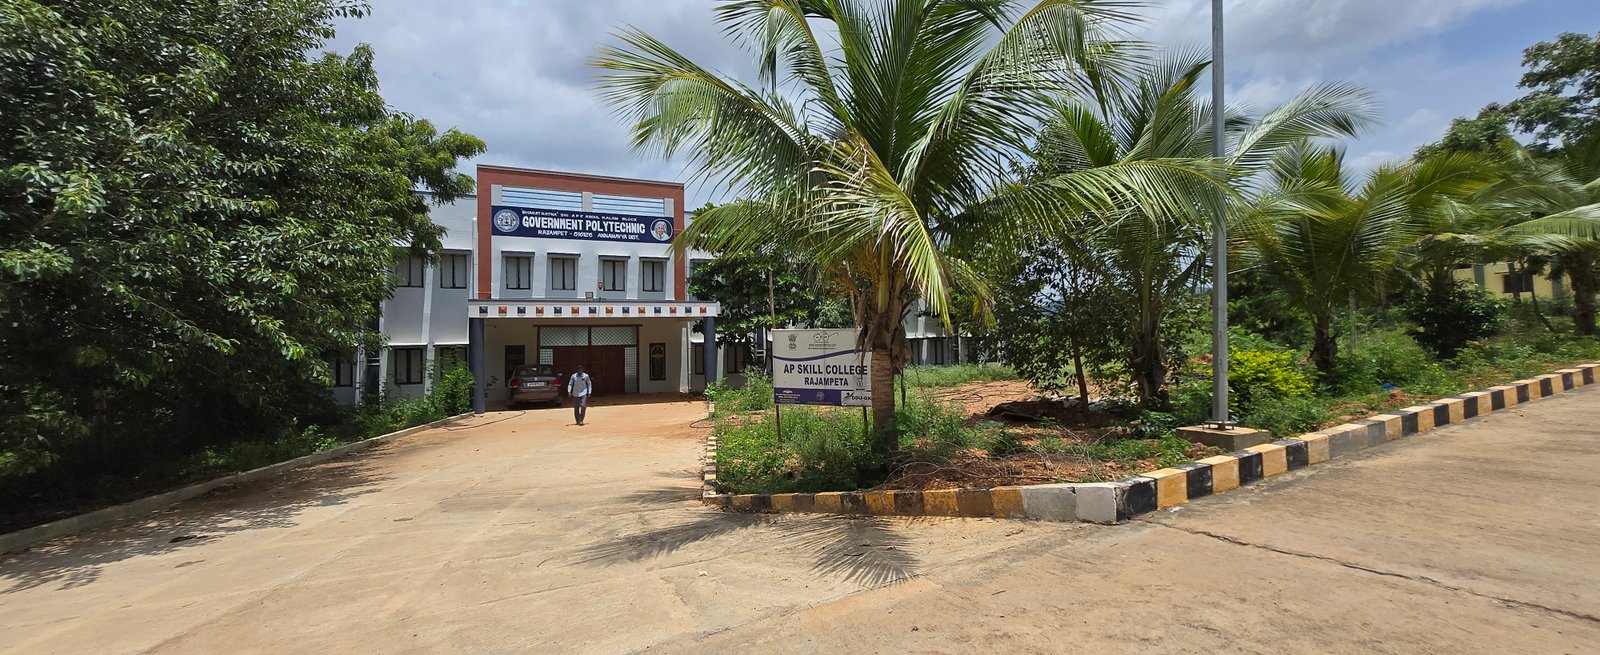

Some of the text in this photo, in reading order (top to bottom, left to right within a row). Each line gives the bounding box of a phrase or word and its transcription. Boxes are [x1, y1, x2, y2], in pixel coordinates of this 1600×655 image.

[522, 216, 646, 234] GOVERNMENT POLYTECHNIC
[784, 364, 868, 375] AP SKILL COLLEGE
[804, 377, 849, 387] RAJAMPETA
